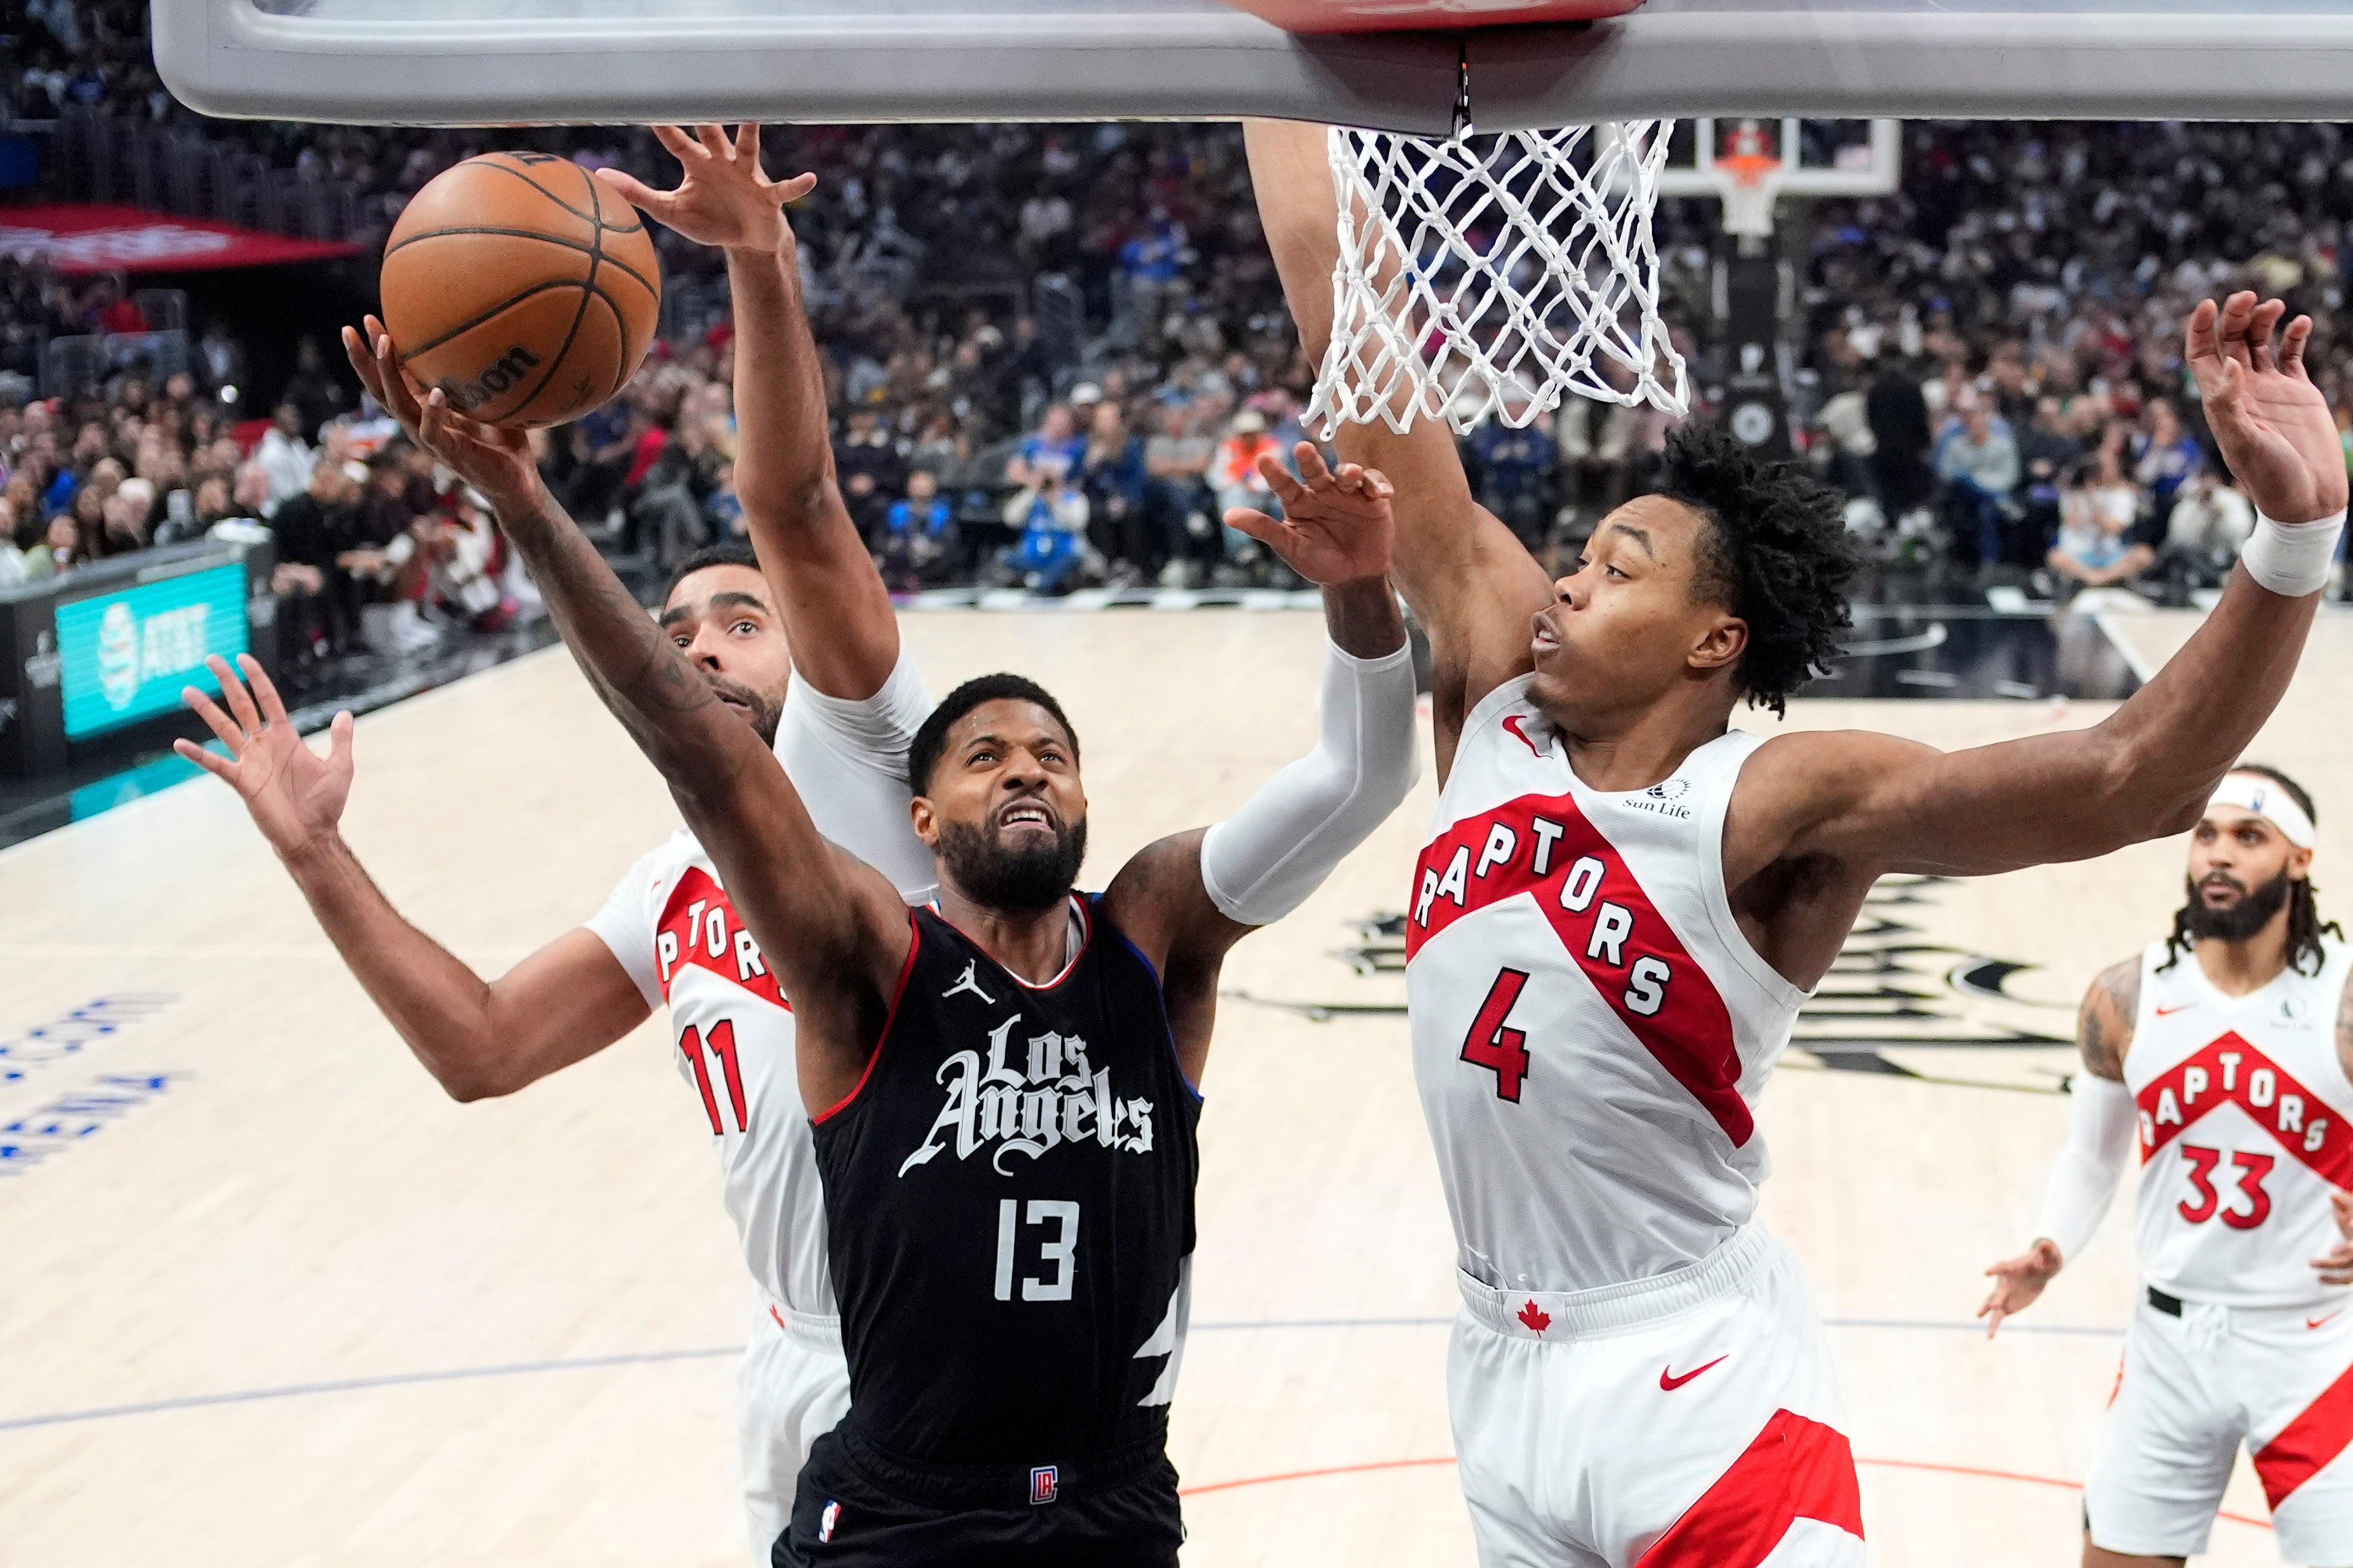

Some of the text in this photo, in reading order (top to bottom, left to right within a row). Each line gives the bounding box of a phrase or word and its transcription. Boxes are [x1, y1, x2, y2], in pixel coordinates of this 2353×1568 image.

[1622, 799, 1691, 819] Sun Life
[657, 898, 789, 1004] PTOR
[1413, 815, 1672, 1018] RAPTORS
[678, 1019, 747, 1136] 11
[978, 1013, 1094, 1090] Los
[1460, 967, 1530, 1104] 4
[898, 1049, 1155, 1178] Angeles
[2139, 1051, 2329, 1152] RAPTORS
[2177, 1142, 2275, 1231] 33
[994, 1199, 1080, 1302] 13
